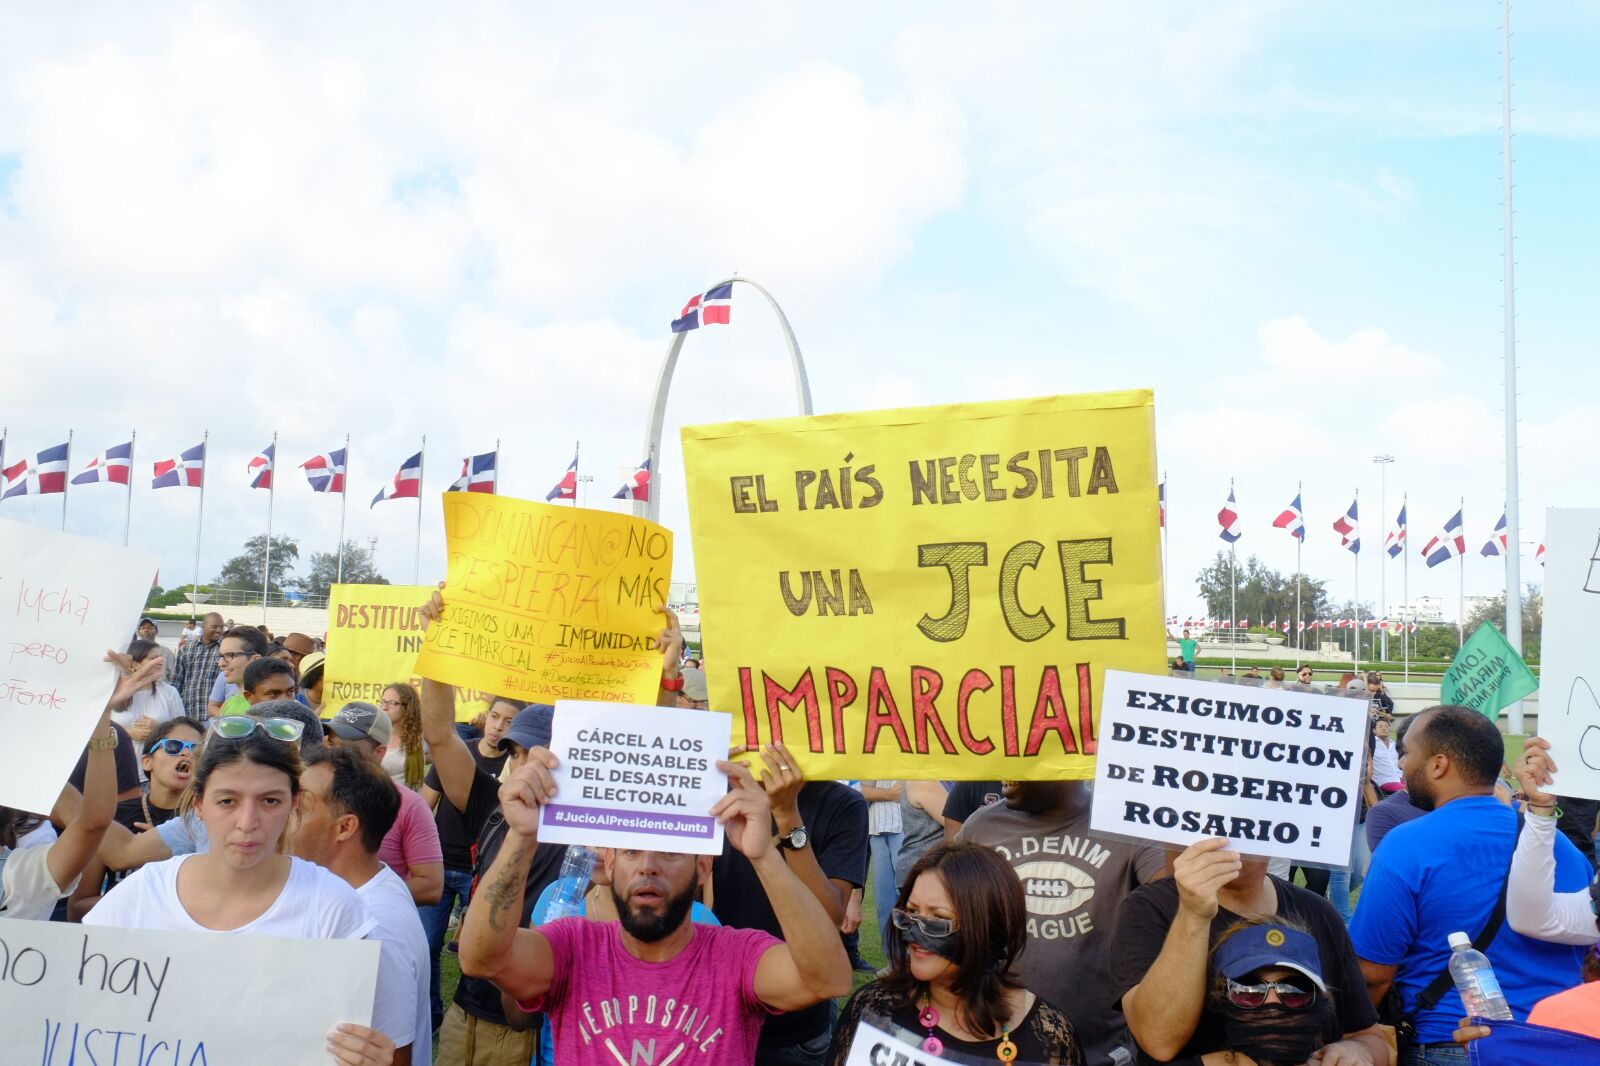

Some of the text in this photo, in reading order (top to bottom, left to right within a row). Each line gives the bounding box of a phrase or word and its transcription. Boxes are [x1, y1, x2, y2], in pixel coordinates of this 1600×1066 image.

[730, 446, 1119, 513] EL PAÍS NECESITA
[625, 525, 668, 560] NO
[450, 552, 600, 620] DESPIERTA
[617, 567, 665, 611] MÁS
[779, 537, 1129, 642] UNA JCE
[336, 603, 423, 631] DESTITUC
[505, 620, 535, 642] UNA
[426, 625, 536, 671] JCE IMPARCIAL
[556, 624, 659, 652] IMPUNIDAD
[331, 681, 389, 700] ROBER
[737, 662, 1097, 757] IMPARCIAL
[1126, 689, 1345, 733] EXIGIMOS LA
[577, 727, 703, 752] CÁRCEL A LOS
[1111, 722, 1354, 771] DESTITUCION
[568, 748, 708, 771] RESPONSABLES
[571, 766, 702, 789] DEL DESASTRE
[582, 786, 687, 807] ELECTORAL
[1107, 763, 1348, 809] DE ROBERTO
[555, 811, 708, 833] #JucioAlPresidenteJunta
[1123, 800, 1322, 847] ROSARIO !
[1026, 912, 1094, 940] AGUE
[78, 934, 170, 1022] hay
